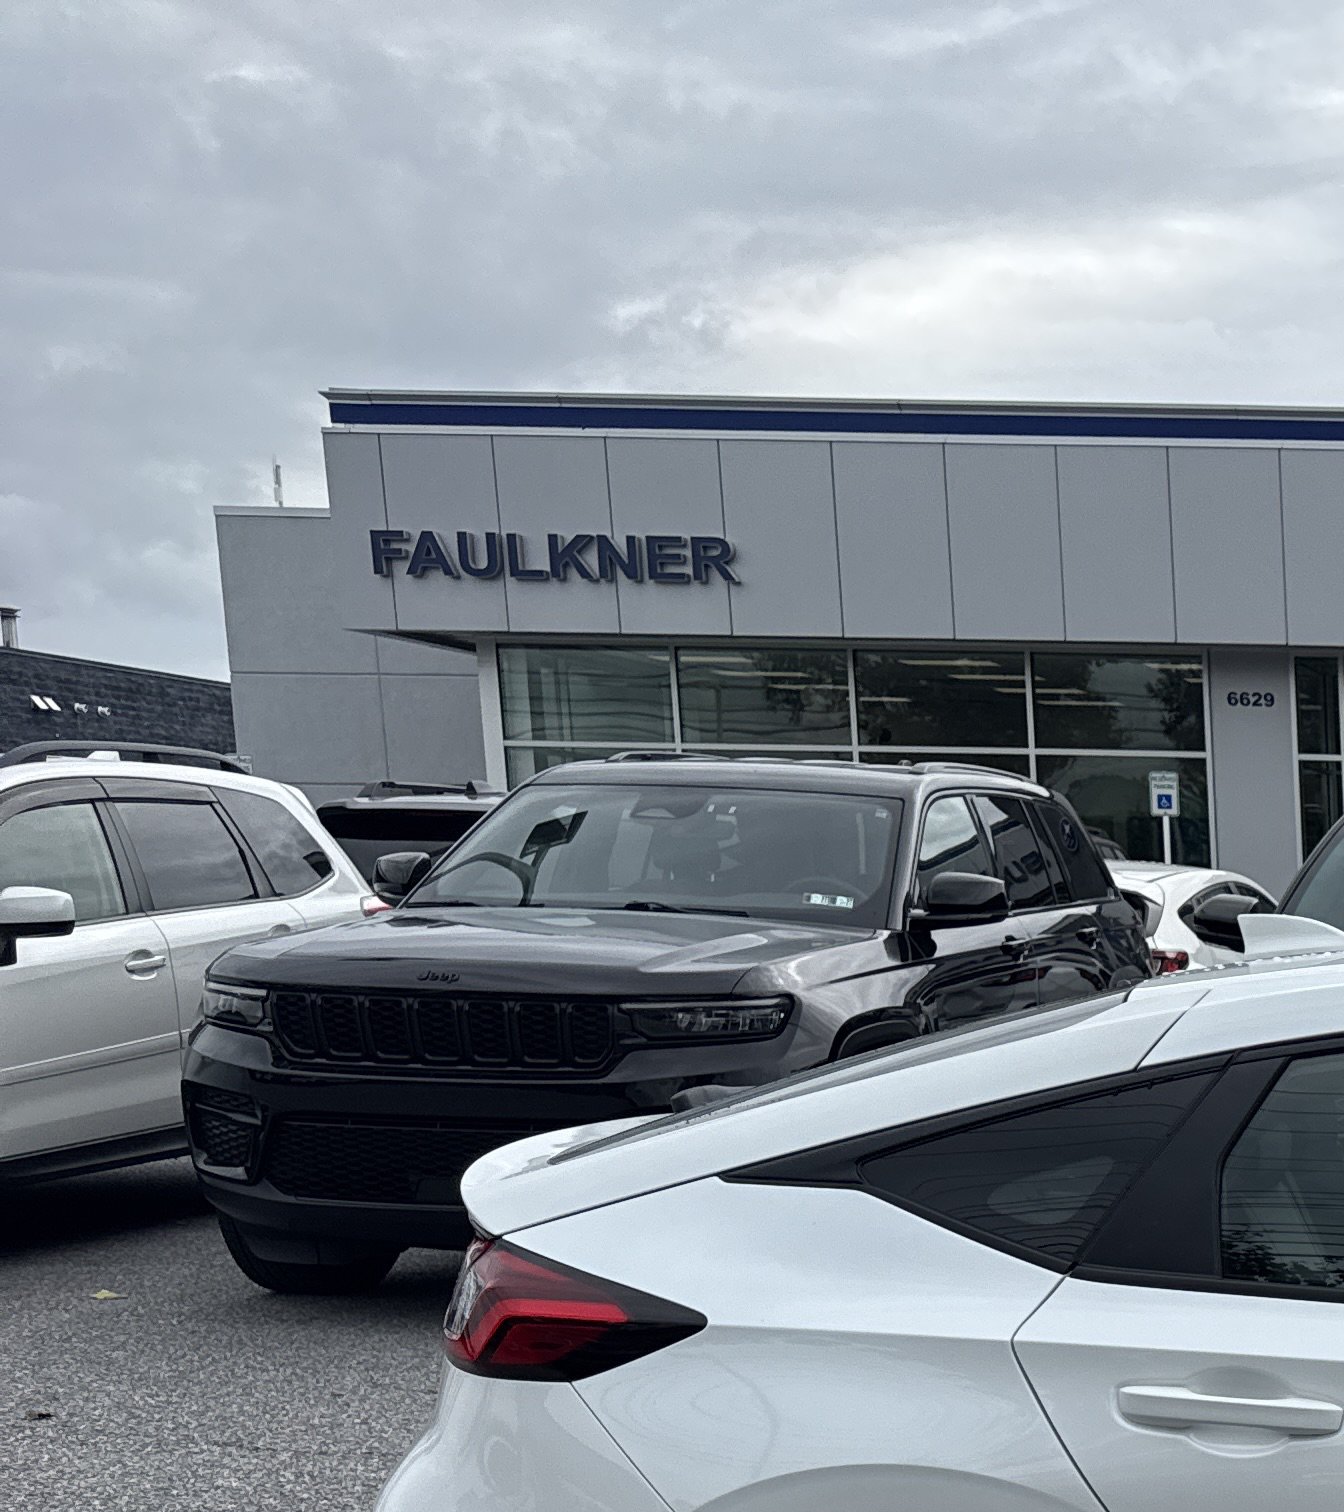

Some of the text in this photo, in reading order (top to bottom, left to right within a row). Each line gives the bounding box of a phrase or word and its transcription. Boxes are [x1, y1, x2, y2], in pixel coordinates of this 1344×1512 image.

[369, 530, 740, 583] FAULKNER
[1227, 692, 1274, 707] 6629
[416, 970, 460, 984] Jeep
